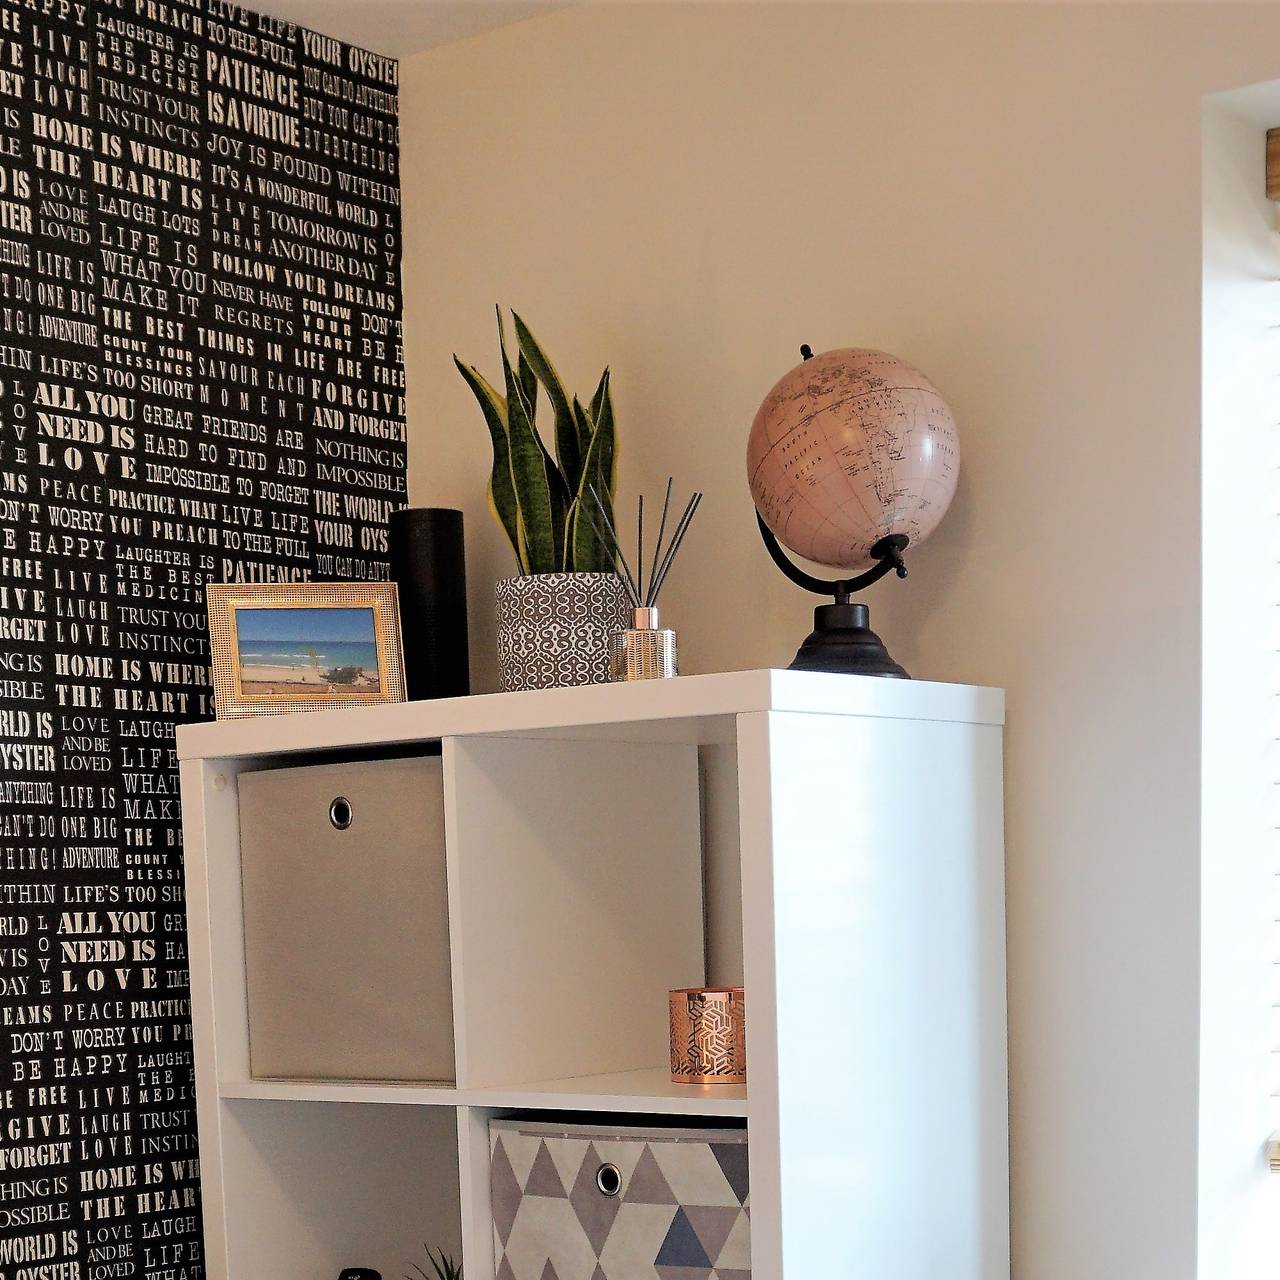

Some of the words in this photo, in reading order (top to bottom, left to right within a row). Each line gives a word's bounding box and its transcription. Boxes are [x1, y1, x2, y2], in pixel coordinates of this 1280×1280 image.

[302, 29, 341, 67] YOUR
[97, 102, 200, 149] INSTINCTS
[13, 169, 30, 198] IS
[215, 305, 293, 335] REGRETS
[63, 847, 119, 868] ADVENTURE
